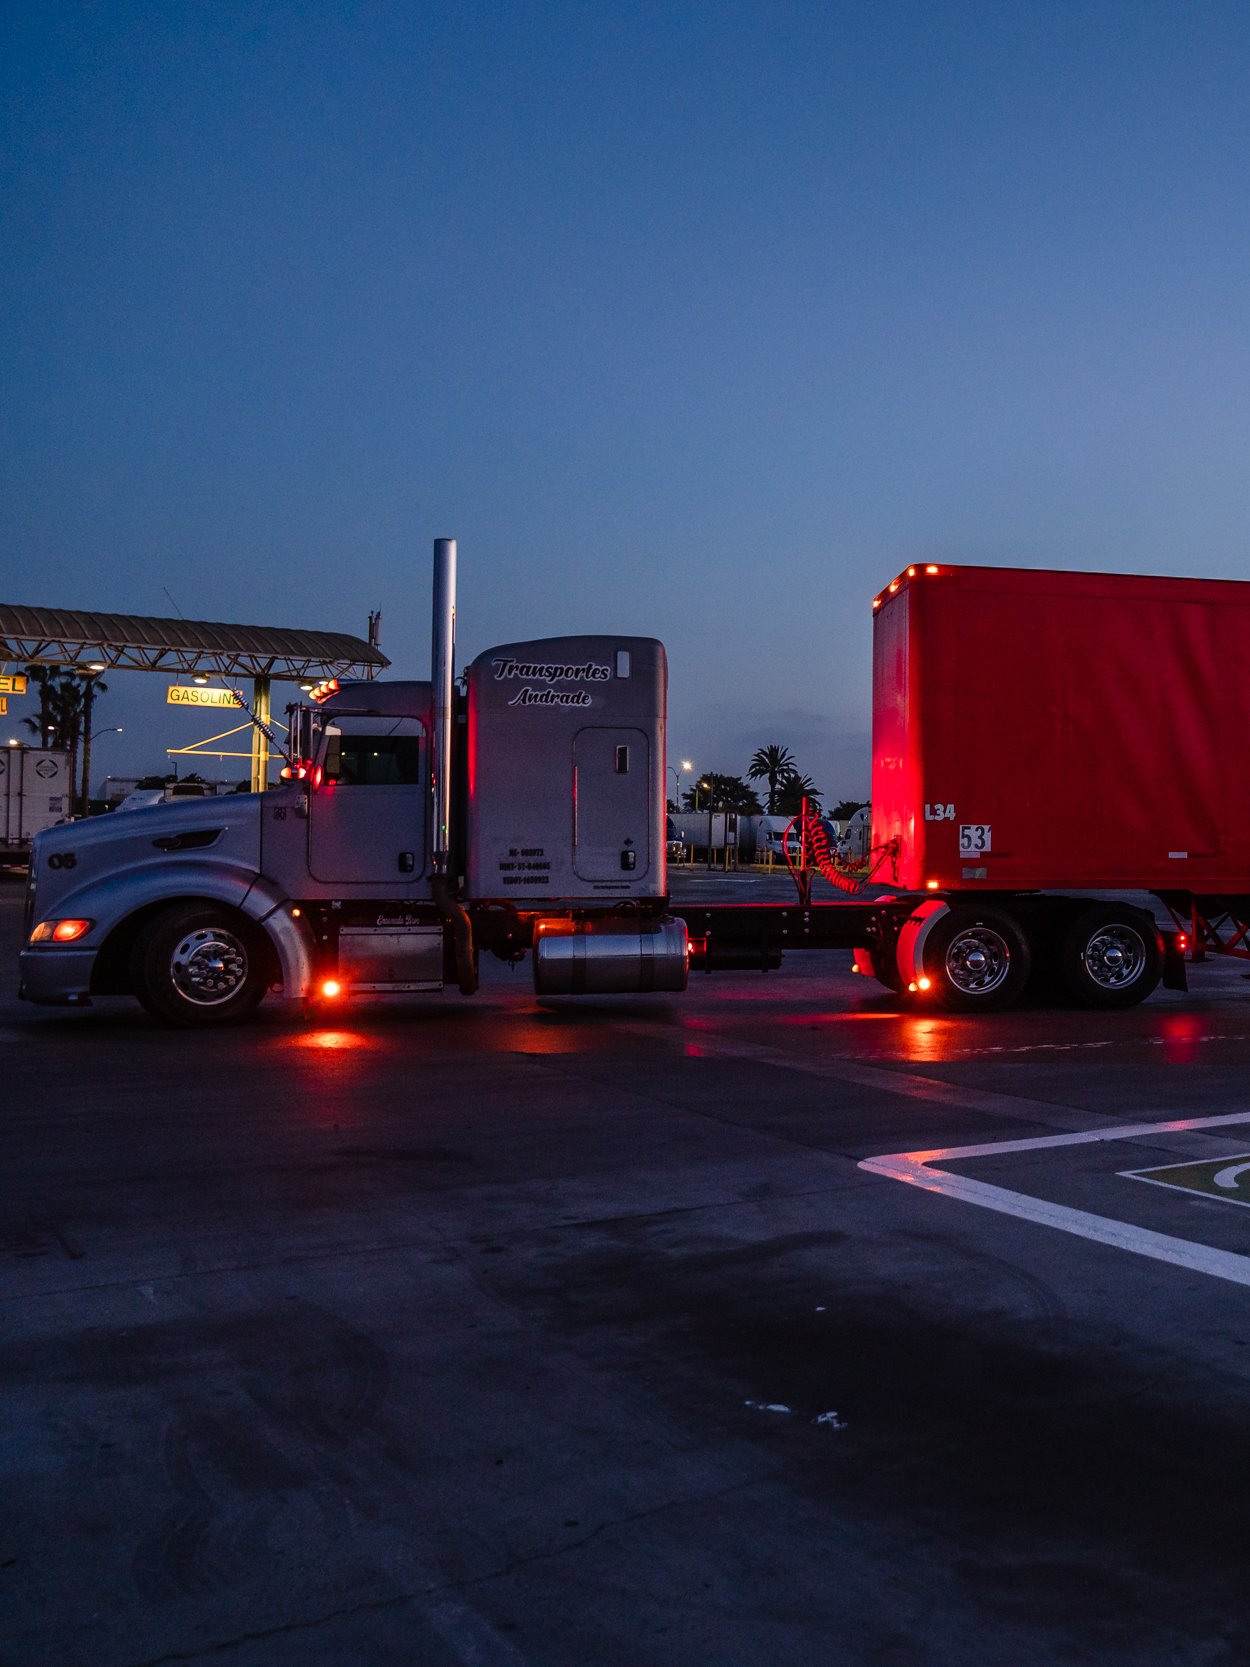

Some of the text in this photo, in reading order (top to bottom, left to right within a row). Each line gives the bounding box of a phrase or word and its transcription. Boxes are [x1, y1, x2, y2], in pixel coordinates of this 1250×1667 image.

[491, 657, 611, 684] Transportes
[507, 686, 593, 706] Andrade
[924, 803, 956, 821] L34
